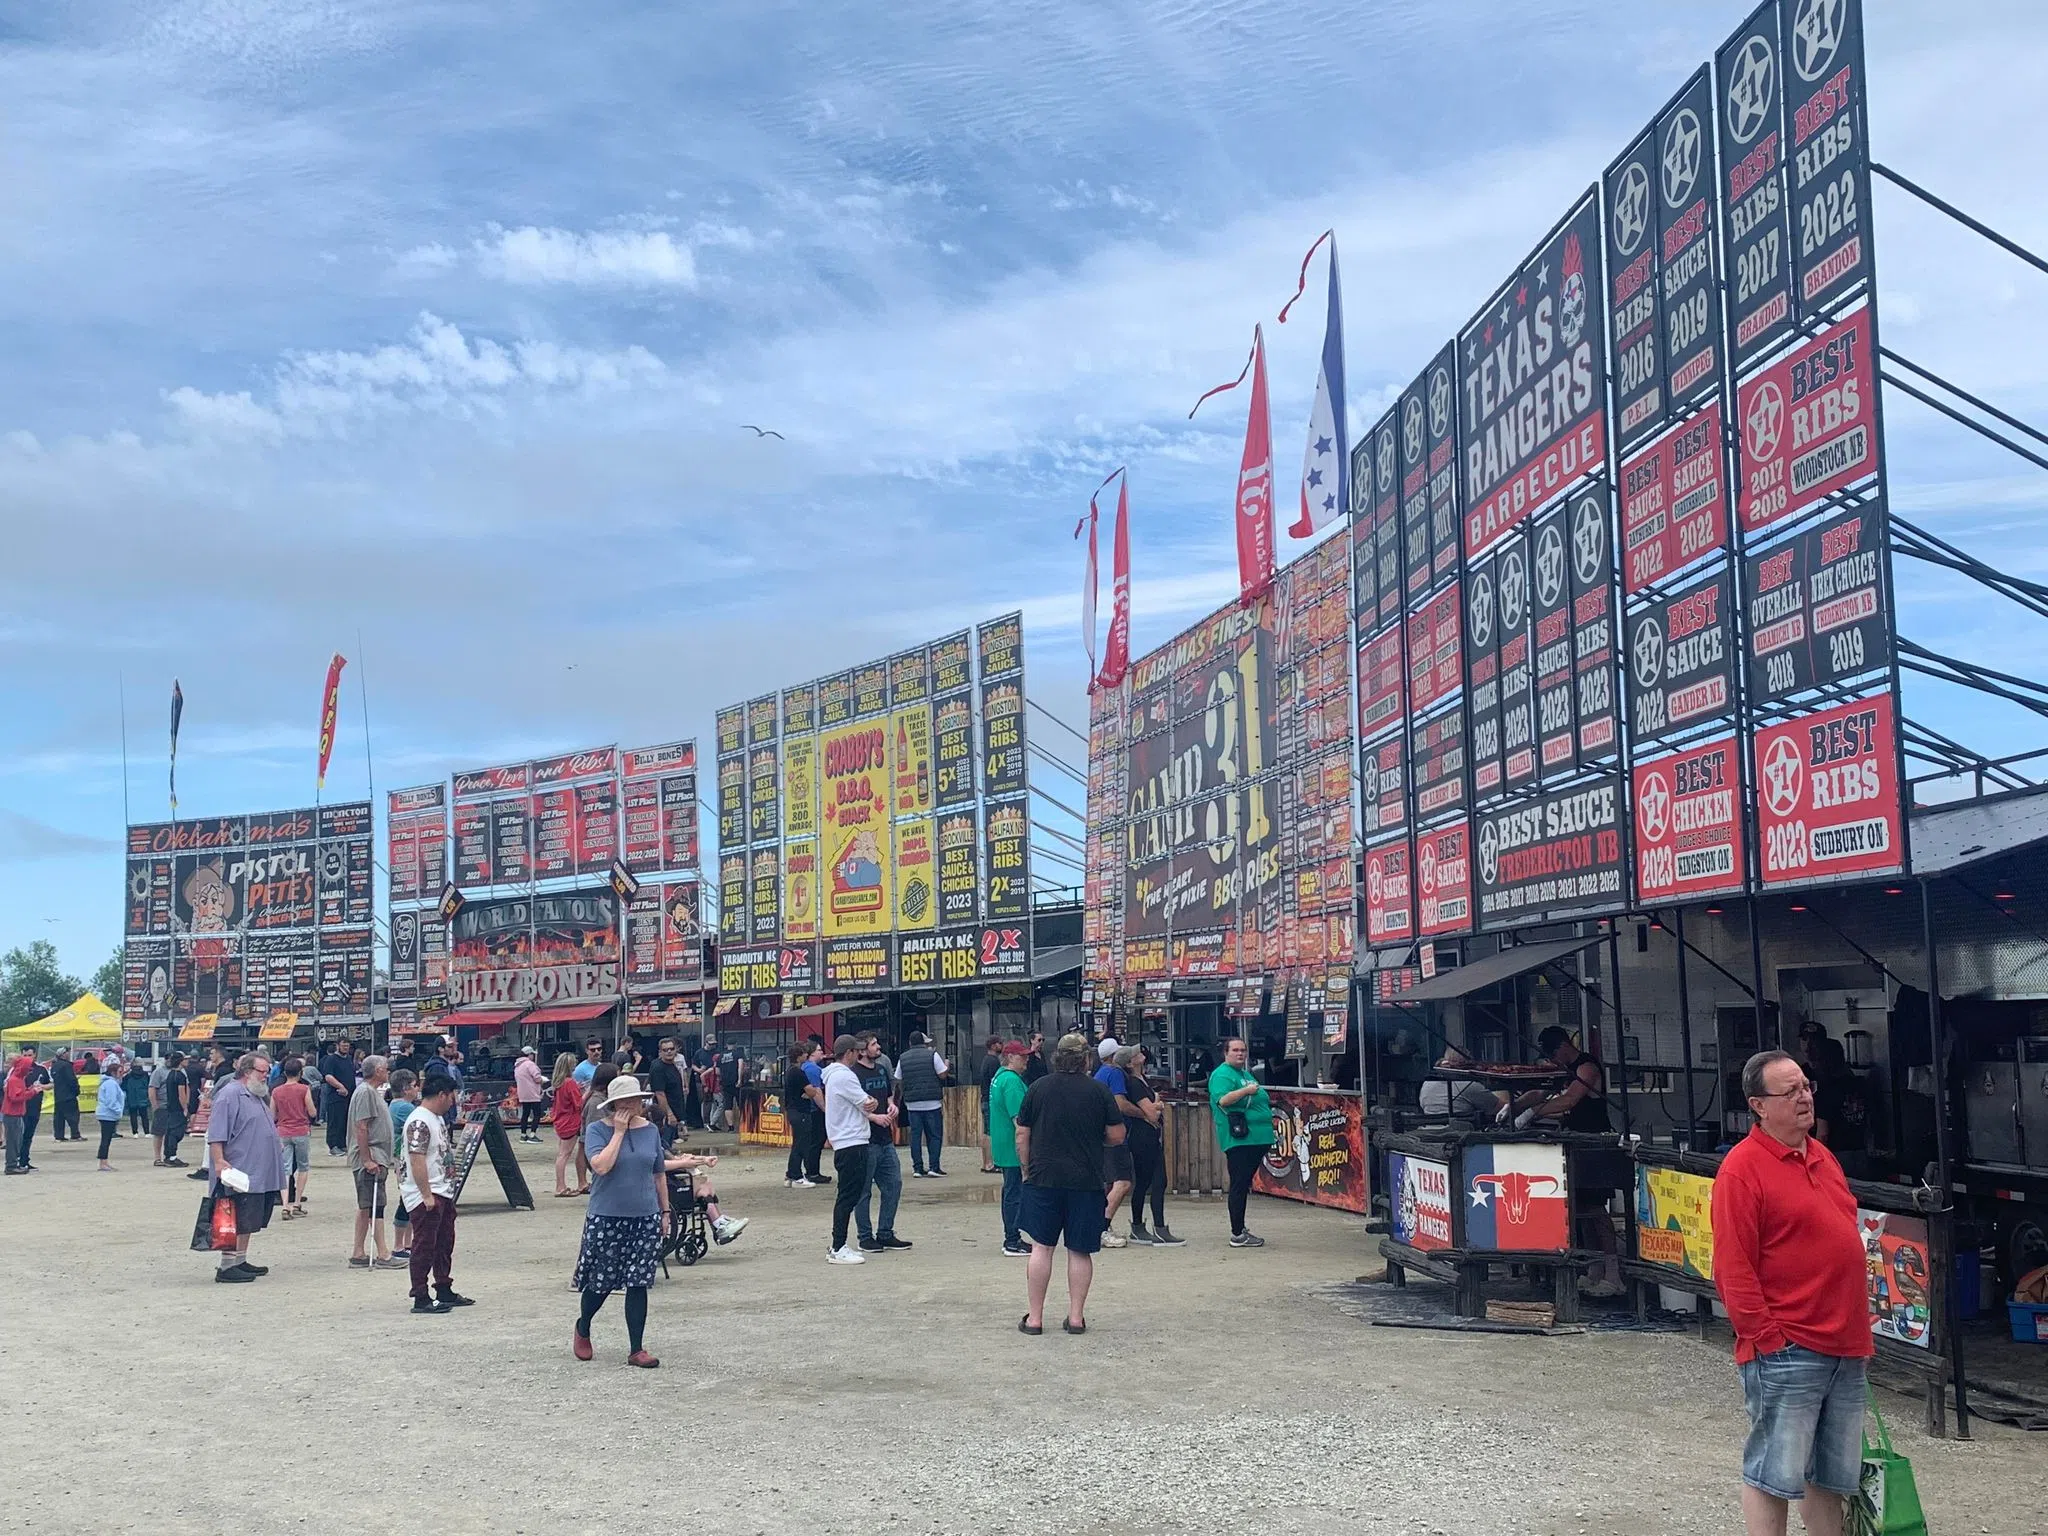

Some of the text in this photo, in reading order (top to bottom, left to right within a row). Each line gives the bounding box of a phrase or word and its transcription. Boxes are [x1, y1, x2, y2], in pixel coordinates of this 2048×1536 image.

[1740, 82, 1760, 113] #1
[1794, 63, 1850, 147] BEST
[1729, 130, 1777, 204] BEST
[1796, 111, 1852, 189] RIBS
[1731, 174, 1779, 244] RIBS
[1800, 168, 1857, 259] 2022
[1664, 197, 1706, 265] BEST
[1615, 247, 1652, 307] BEST
[1665, 236, 1707, 300] SAUCE
[1738, 226, 1779, 305] 2017
[1806, 242, 1858, 297] BRANDON
[1615, 284, 1653, 342] RIBS
[1670, 287, 1708, 358] 2019
[1740, 295, 1784, 344] BRANDON
[1466, 294, 1553, 434] TEXAS
[1620, 332, 1655, 397] 2016
[1673, 350, 1712, 395] WINNIPEG
[1791, 326, 1858, 406] BEST
[1467, 341, 1592, 504] RANGERS
[1792, 377, 1860, 450] RIBS
[1673, 417, 1711, 468] BEST
[1793, 431, 1864, 489] WOODSTOCK NB
[1470, 424, 1594, 548] BARBECUE
[1626, 453, 1660, 499] BEST
[1674, 449, 1713, 497] SAUCE
[1751, 456, 1784, 495] 2017
[1628, 482, 1663, 526] SAUCE
[1750, 486, 1787, 522] 2018
[1680, 510, 1714, 558] 2022
[1820, 517, 1861, 566] BEST
[1633, 540, 1664, 583] 2022
[1759, 548, 1794, 592] BEST
[1667, 584, 1718, 641] BEST
[1752, 581, 1803, 628] OVERALL
[1816, 592, 1873, 630] FREDERICTON NB
[988, 648, 1011, 664] BEST
[1133, 628, 1207, 694] ALABAMA'S
[1209, 593, 1267, 651] FINEST
[1537, 641, 1568, 678] SAUCE
[1576, 619, 1609, 659] RIBS
[1667, 626, 1723, 680] SAUCE
[1830, 626, 1864, 673] 2019
[898, 680, 919, 692] BEST
[936, 672, 965, 691] SAUCE
[938, 664, 961, 681] BEST
[986, 656, 1016, 675] SAUCE
[1503, 664, 1527, 701] RIBS
[1767, 651, 1795, 693] 2018
[858, 699, 883, 712] SAUCE
[860, 691, 880, 703] BEST
[1540, 685, 1570, 734] 2023
[1579, 666, 1609, 717] 2023
[1636, 687, 1665, 735] 2022
[1672, 684, 1724, 715] GANDER NL
[319, 686, 338, 758] BBQ
[941, 729, 965, 747] BEST
[989, 729, 1018, 749] RIBS
[990, 716, 1015, 734] BEST
[1475, 718, 1498, 762] 2023
[1505, 703, 1529, 750] 2023
[1809, 709, 1877, 767] BEST
[495, 768, 526, 789] Love
[535, 763, 565, 779] and
[569, 750, 612, 776] Ribs!
[634, 746, 682, 766] BILLY BONES
[824, 728, 885, 780] CRABBY'S
[940, 742, 968, 761] RIBS
[1129, 743, 1203, 871] CAMP
[1204, 640, 1270, 865] 31
[1674, 749, 1725, 796] BEST
[1811, 758, 1880, 810] RIBS
[838, 804, 871, 828] SHACK
[1498, 785, 1615, 851] BEST SAUCE
[1672, 789, 1733, 834] CHICKEN
[672, 852, 691, 863] 2023
[792, 843, 810, 856] VOTE
[945, 848, 969, 864] BEST
[994, 838, 1019, 853] BEST
[1438, 830, 1463, 864] BEST
[1499, 829, 1619, 884] FREDERICTON NB
[1767, 819, 1808, 871] 2023
[1814, 823, 1884, 856] SUDBURY ON
[941, 863, 967, 879] SAUCE
[993, 853, 1022, 869] RIBS
[1213, 844, 1280, 911] BBQ RIBS
[1438, 858, 1466, 888] SAUCE
[1642, 845, 1673, 889] 2023
[1678, 849, 1730, 877] KINGSTON ON
[248, 872, 314, 910] PETE'S
[724, 893, 743, 907] RIBS
[756, 878, 774, 891] BEST
[941, 875, 975, 893] CHICKEN
[946, 893, 972, 910] 2023
[1180, 877, 1208, 910] DIXIE
[461, 897, 613, 940] WORLD FAMOUS
[753, 901, 777, 917] SAUCE
[756, 916, 775, 931] 2023
[903, 934, 974, 953] HALIFAX NS
[449, 972, 515, 1005] BILLY
[520, 963, 618, 1001] BONES
[636, 964, 655, 973] 2023
[721, 963, 777, 991] BEST RIBS
[901, 949, 977, 982] BEST RIBS
[1309, 1120, 1330, 1132] FINGER
[1318, 1133, 1337, 1149] REAL
[1309, 1148, 1348, 1169] SOUTHERN
[1317, 1168, 1340, 1187] BBQ!!
[1417, 1167, 1445, 1197] TEXAS
[1418, 1212, 1449, 1243] RANGERS
